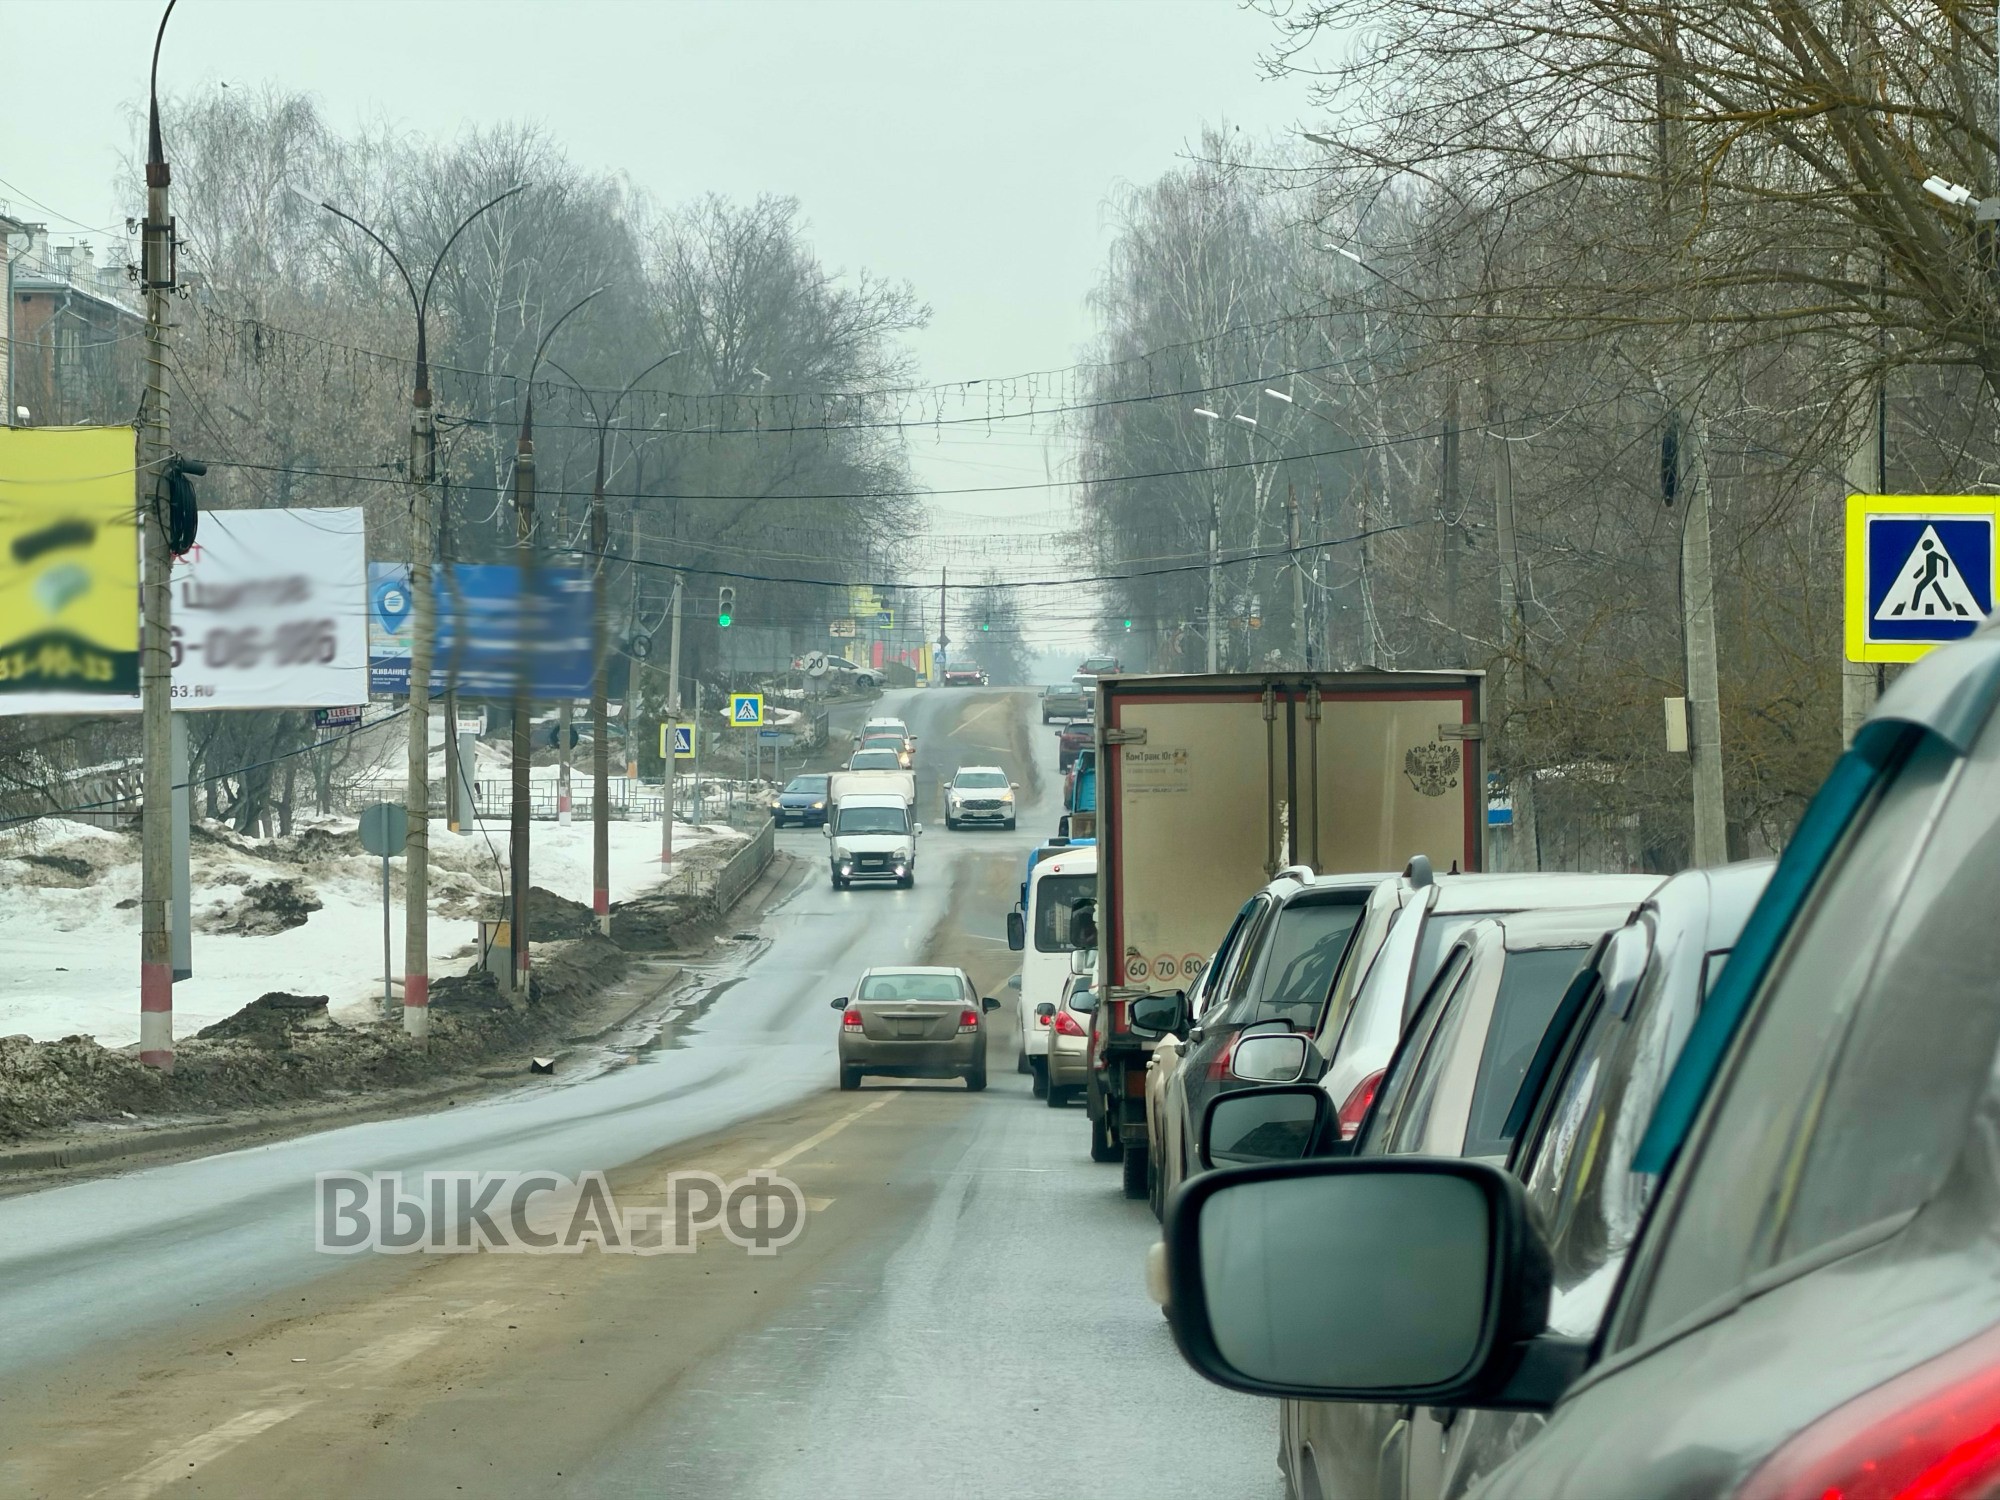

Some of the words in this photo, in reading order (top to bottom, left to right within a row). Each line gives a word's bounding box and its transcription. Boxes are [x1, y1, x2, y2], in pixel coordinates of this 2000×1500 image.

[808, 658, 823, 669] 20
[370, 668, 407, 676] ЖИВАНИЕ
[330, 706, 358, 718] ЦВЕТ
[1129, 962, 1147, 976] 60
[1157, 961, 1175, 975] 70
[1184, 960, 1202, 974] 80
